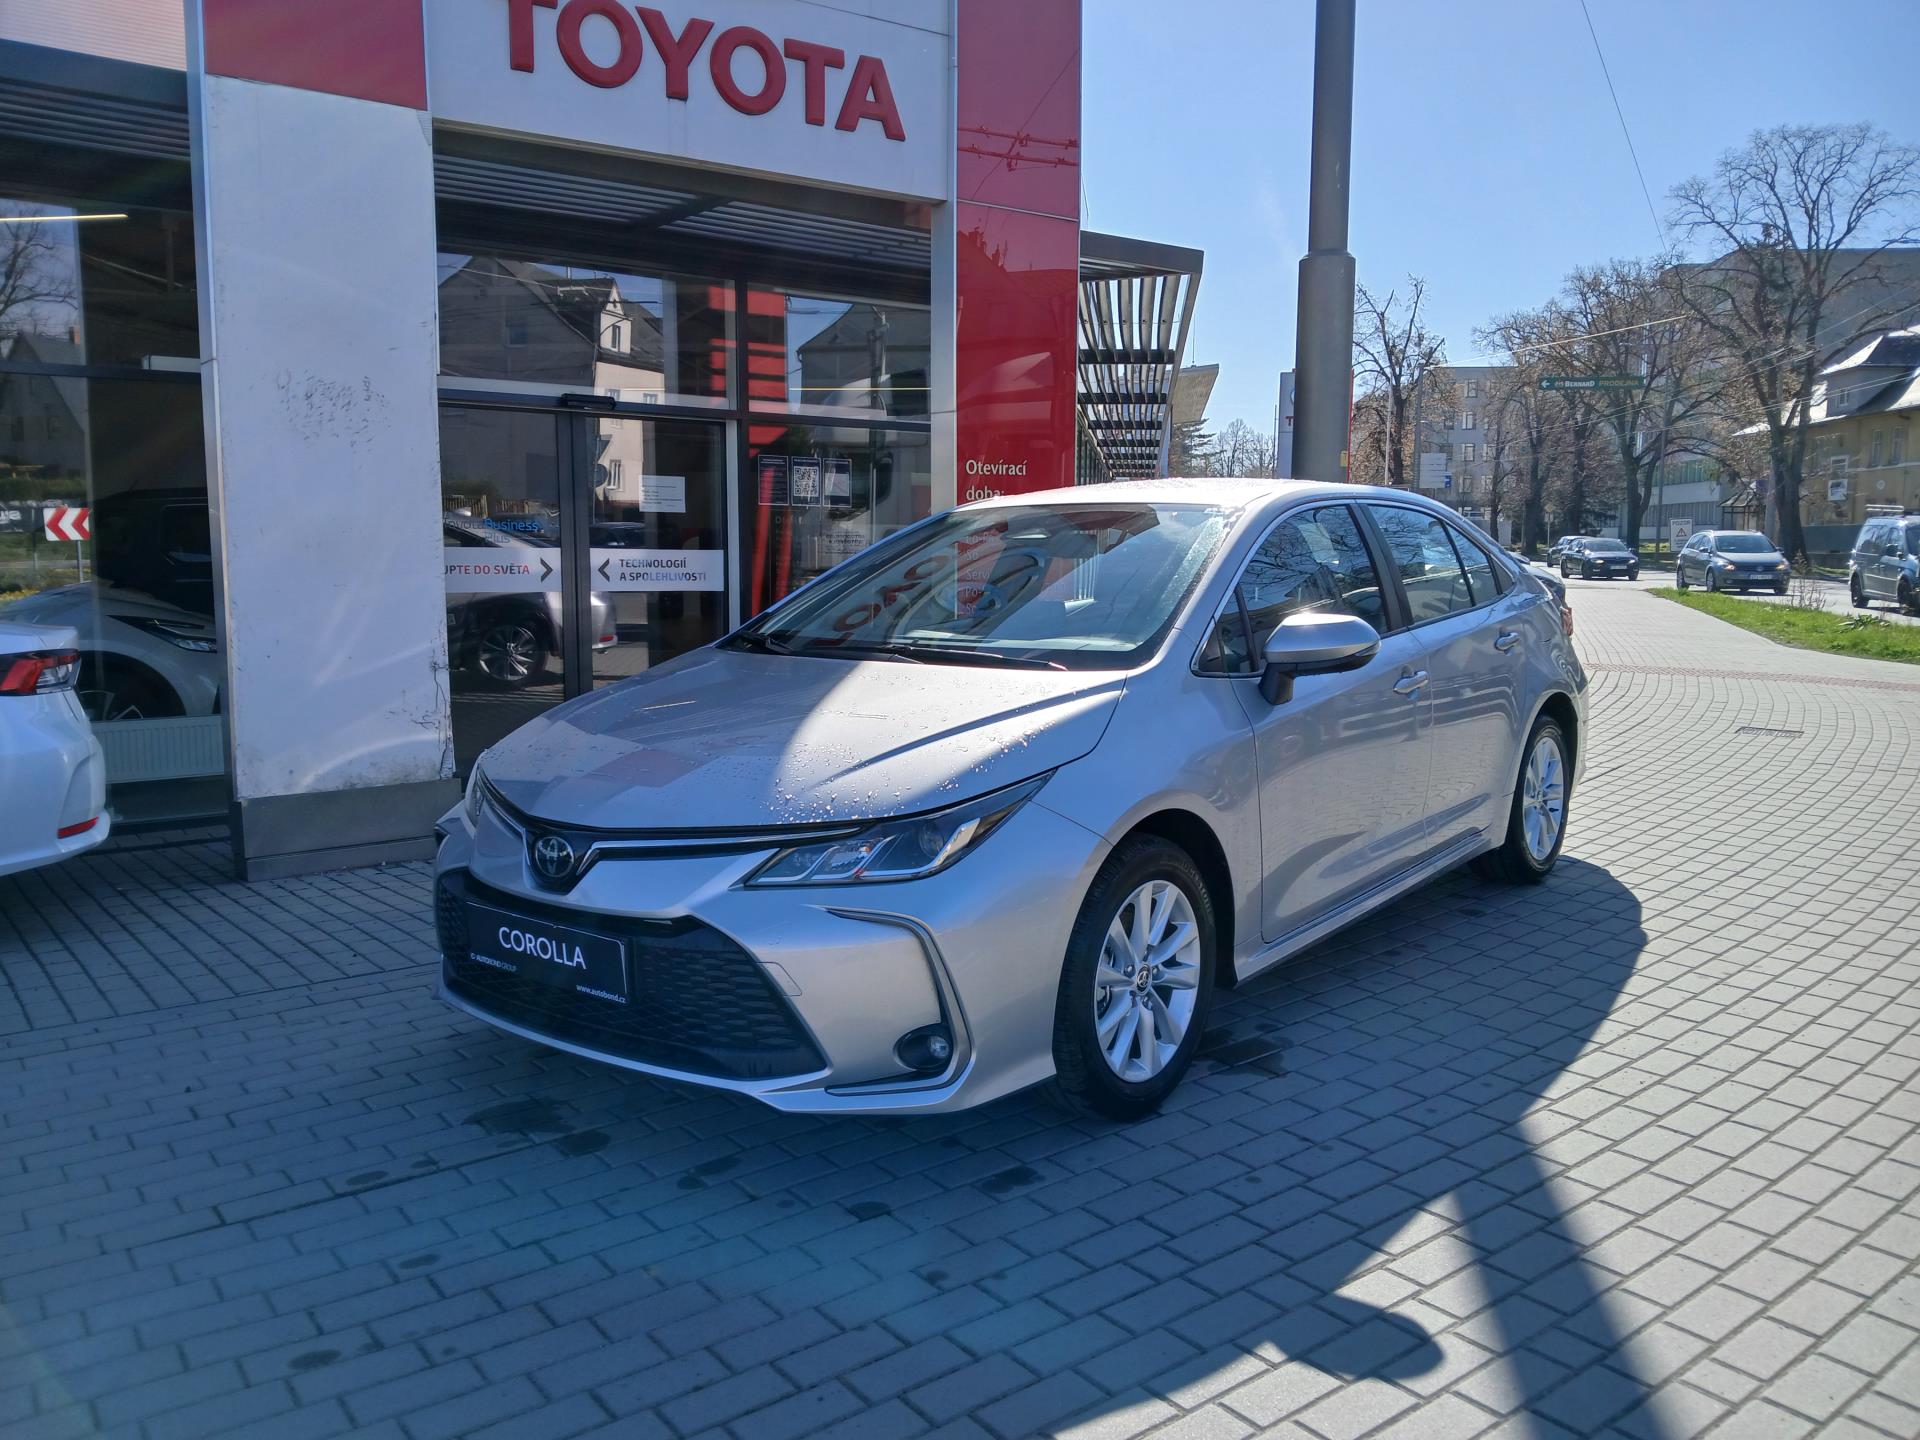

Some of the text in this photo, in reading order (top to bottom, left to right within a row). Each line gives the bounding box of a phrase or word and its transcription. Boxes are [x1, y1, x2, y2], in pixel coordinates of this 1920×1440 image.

[508, 0, 906, 142] TOYOTA
[965, 459, 1028, 476] Otevírací
[474, 564, 491, 575] DO
[494, 562, 530, 575] SVĚTA
[619, 557, 687, 569] TECHNOLOGIÍ
[620, 572, 706, 581] A SPOLEHLIVOSTI
[498, 926, 587, 970] COROLLA
